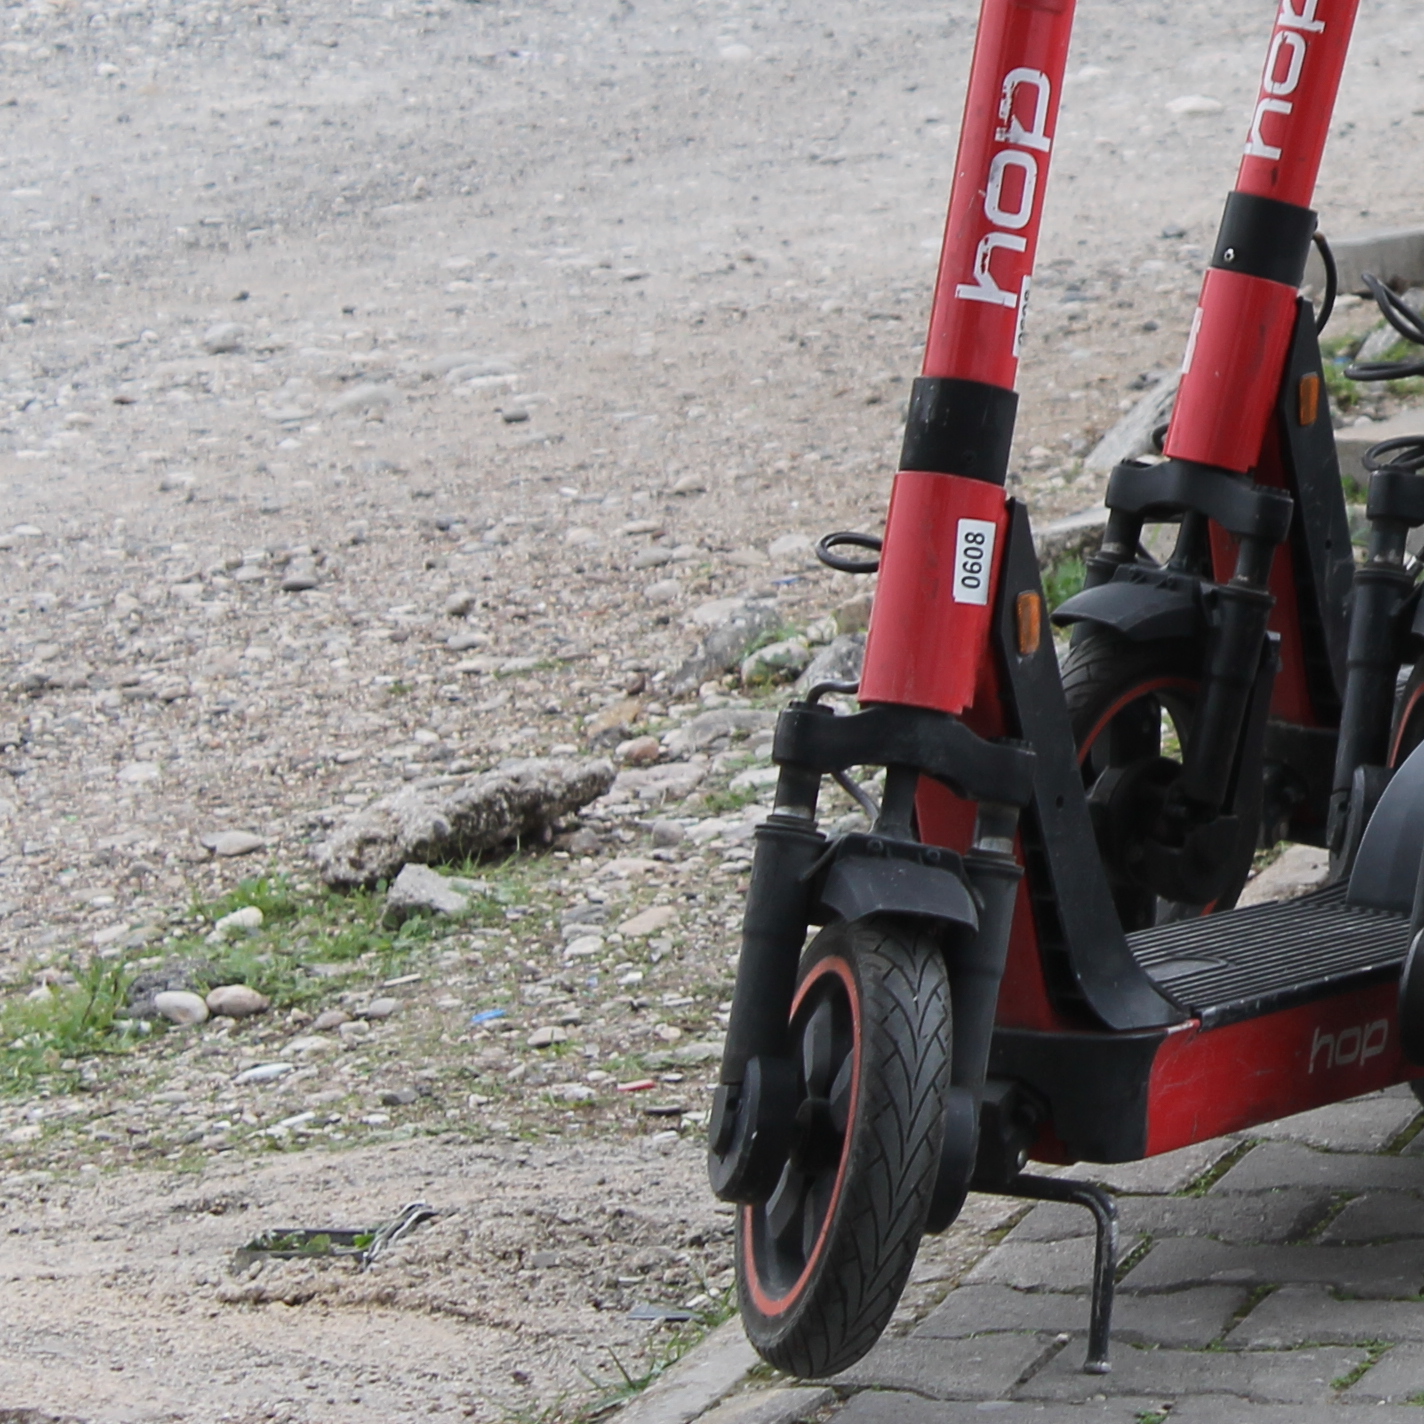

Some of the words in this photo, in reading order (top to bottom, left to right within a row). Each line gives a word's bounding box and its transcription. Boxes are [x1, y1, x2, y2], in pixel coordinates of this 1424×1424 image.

[955, 67, 1052, 309] hop
[961, 532, 985, 589] 0608
[1308, 1018, 1388, 1074] hop
